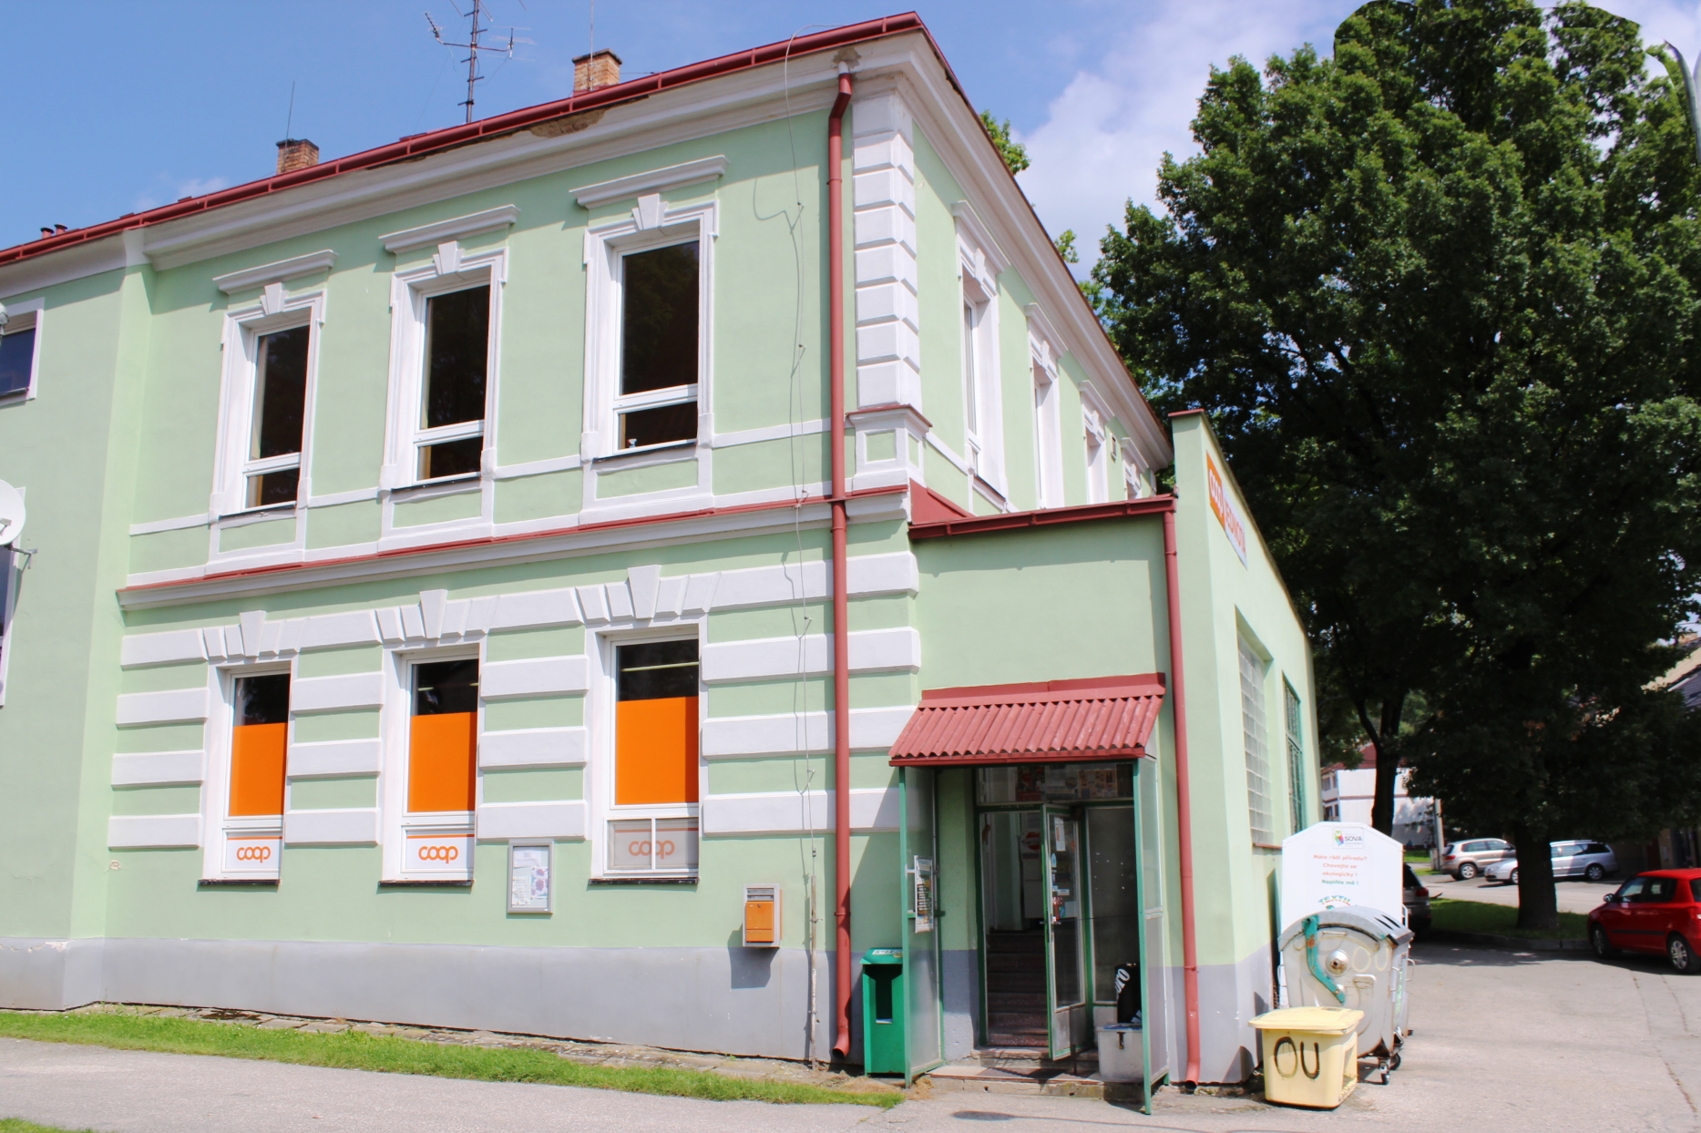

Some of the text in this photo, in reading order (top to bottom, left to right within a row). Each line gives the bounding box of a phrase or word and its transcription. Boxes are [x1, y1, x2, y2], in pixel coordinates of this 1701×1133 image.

[237, 846, 271, 863] coop
[418, 845, 458, 864] coop
[629, 840, 675, 860] coop
[1274, 1036, 1319, 1079] OU
